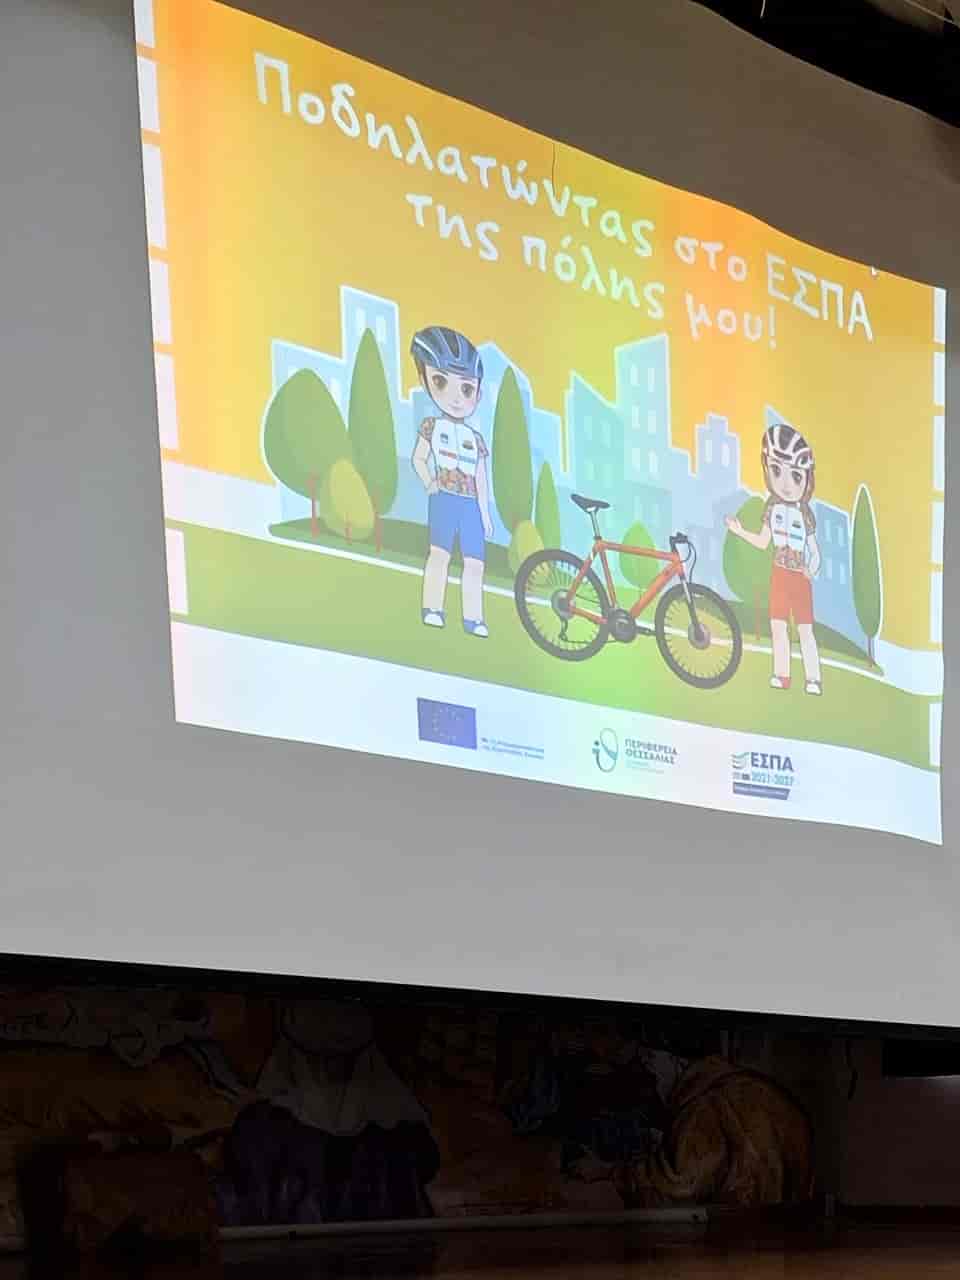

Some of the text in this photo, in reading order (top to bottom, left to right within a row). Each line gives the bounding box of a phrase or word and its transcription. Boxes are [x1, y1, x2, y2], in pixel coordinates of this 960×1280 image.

[254, 51, 874, 342] Ποδηλατώντας στο ΕΣΠΑ
[405, 193, 777, 349] της πόλης μου!
[751, 751, 794, 772] ΕΣΠΑ
